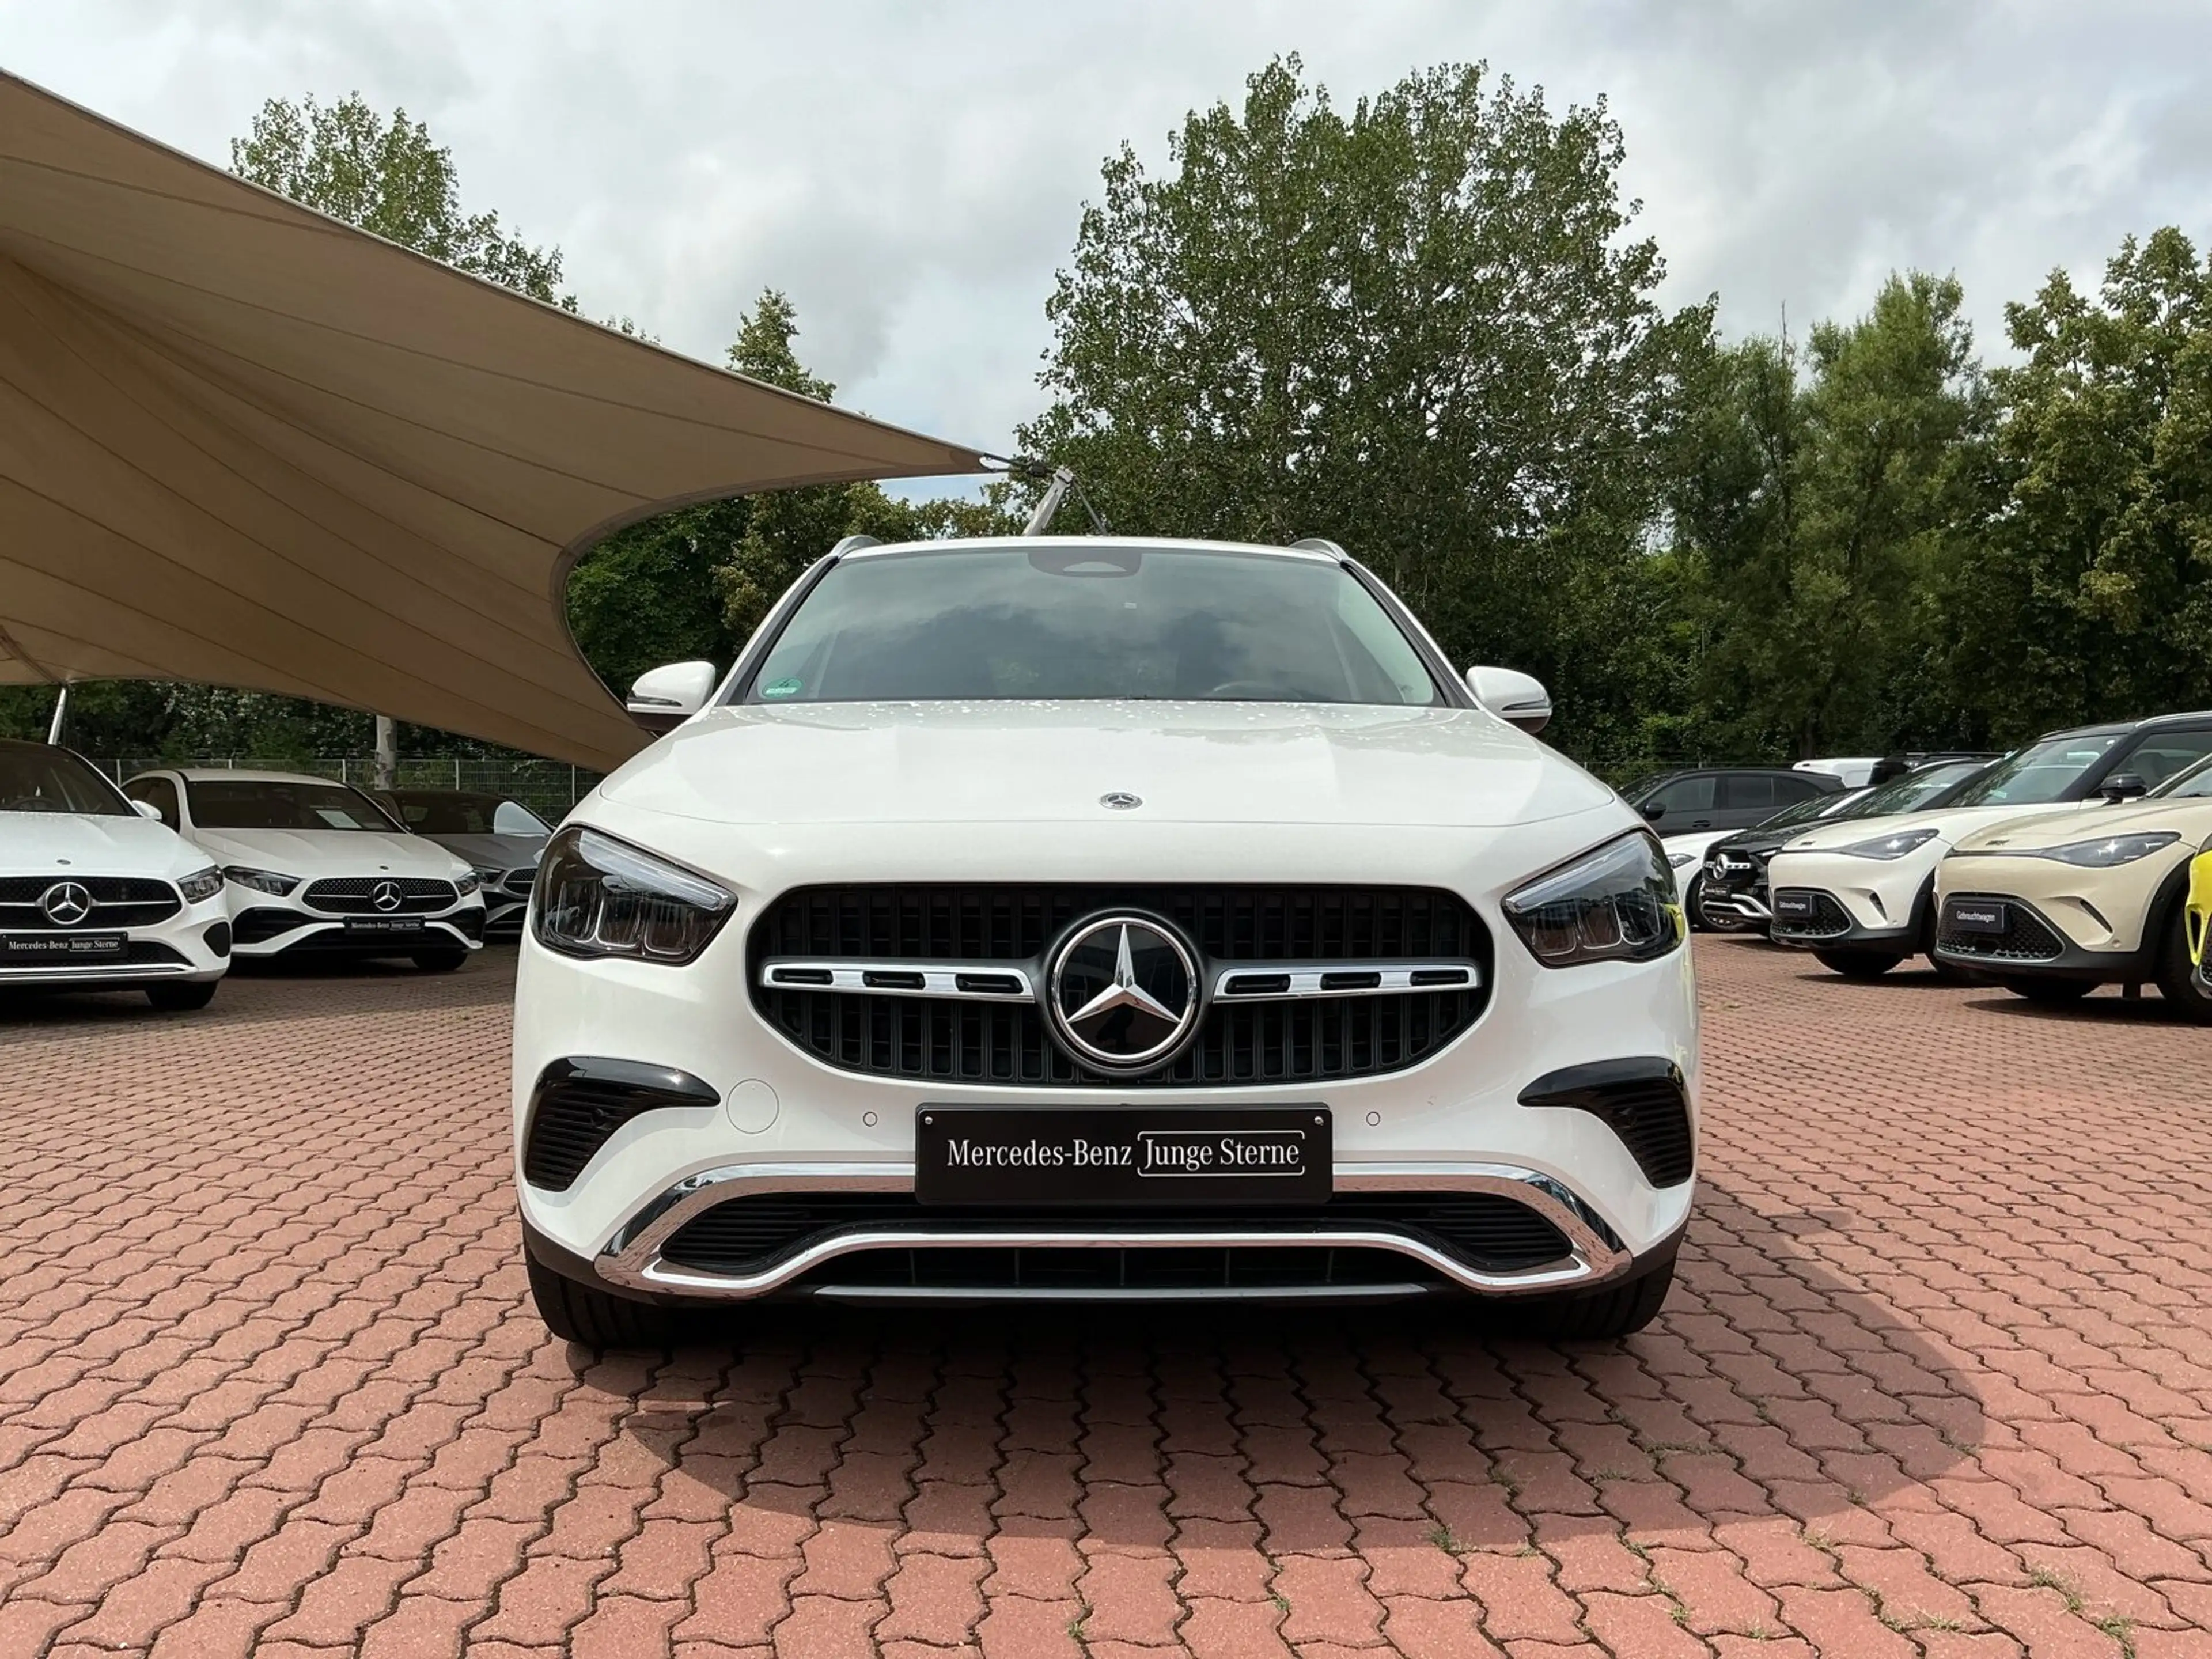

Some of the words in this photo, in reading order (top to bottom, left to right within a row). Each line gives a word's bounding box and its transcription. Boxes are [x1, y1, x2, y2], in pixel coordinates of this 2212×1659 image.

[8, 940, 68, 950] Mercedes-Benz
[71, 941, 93, 949] Junge
[94, 940, 118, 948] Sterne
[946, 1138, 1132, 1166] Mercedes-Benz
[1144, 1138, 1213, 1171] Junge
[1219, 1138, 1300, 1165] Sterne
